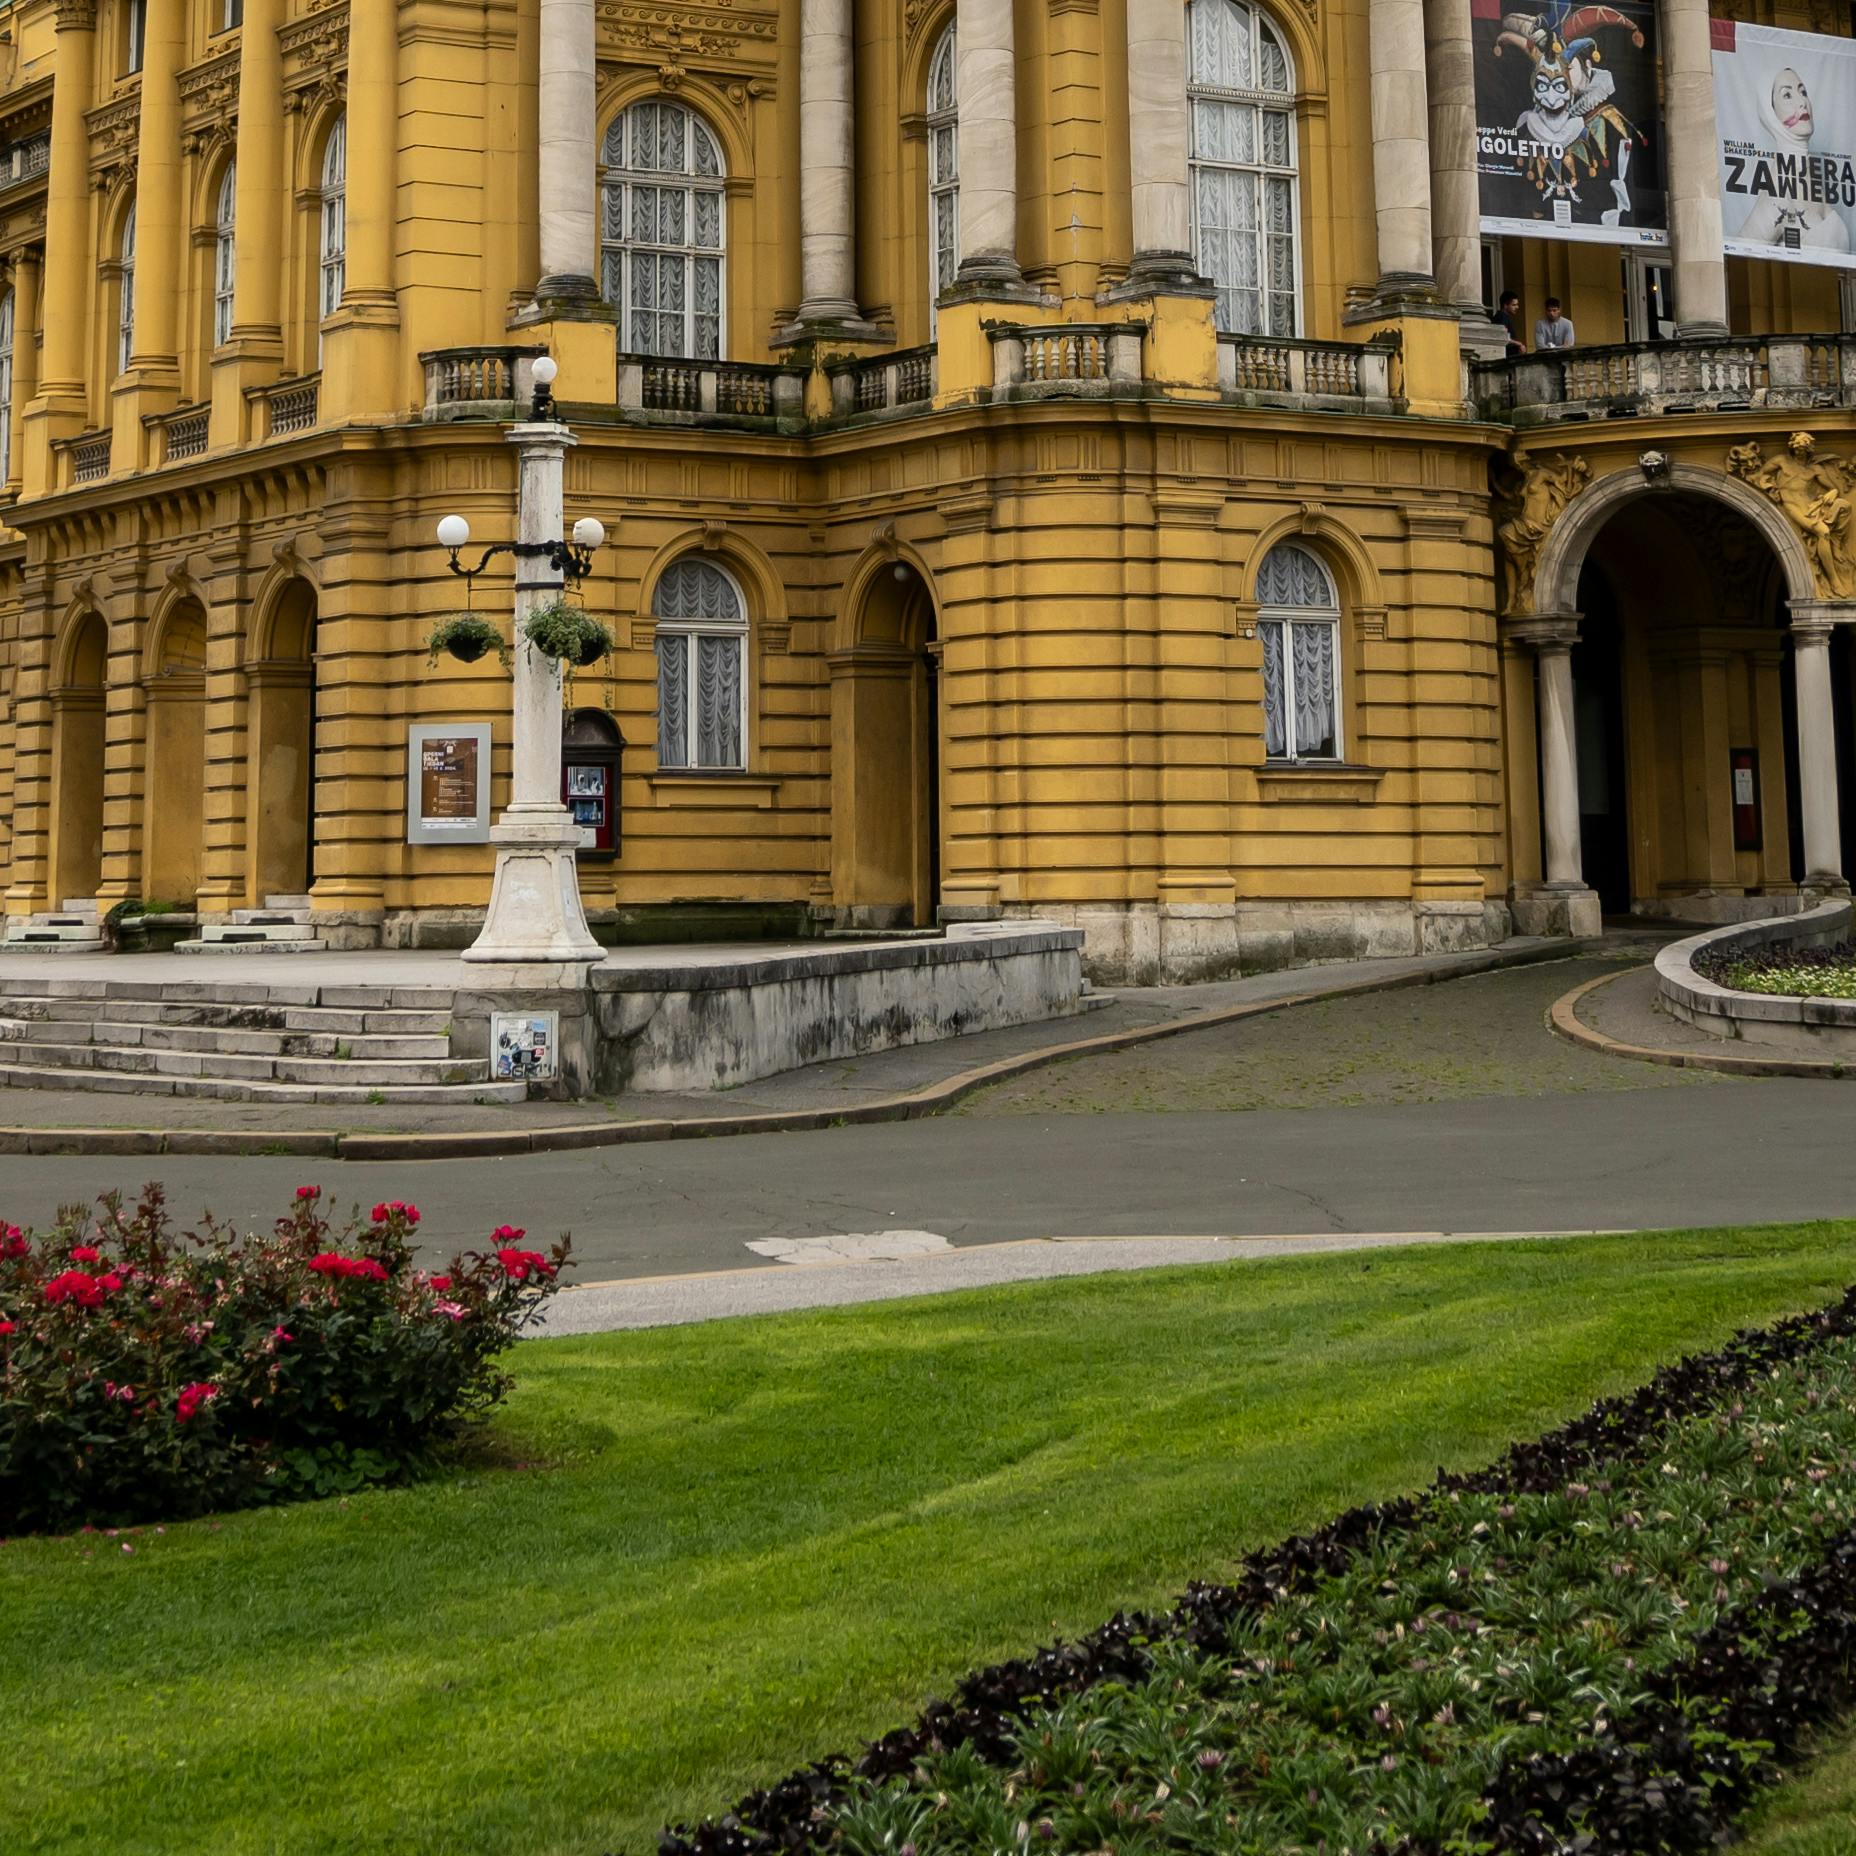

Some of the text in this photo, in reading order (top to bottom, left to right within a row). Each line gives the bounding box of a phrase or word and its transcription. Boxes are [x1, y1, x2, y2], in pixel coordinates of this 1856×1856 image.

[1497, 126, 1518, 136] Verdi
[1476, 136, 1564, 160] IGOLETTO
[1723, 139, 1755, 149] WILLIAM
[1724, 146, 1776, 159] SHAKESPEARE
[1724, 156, 1778, 198] ZA
[1776, 153, 1856, 184] MJERA
